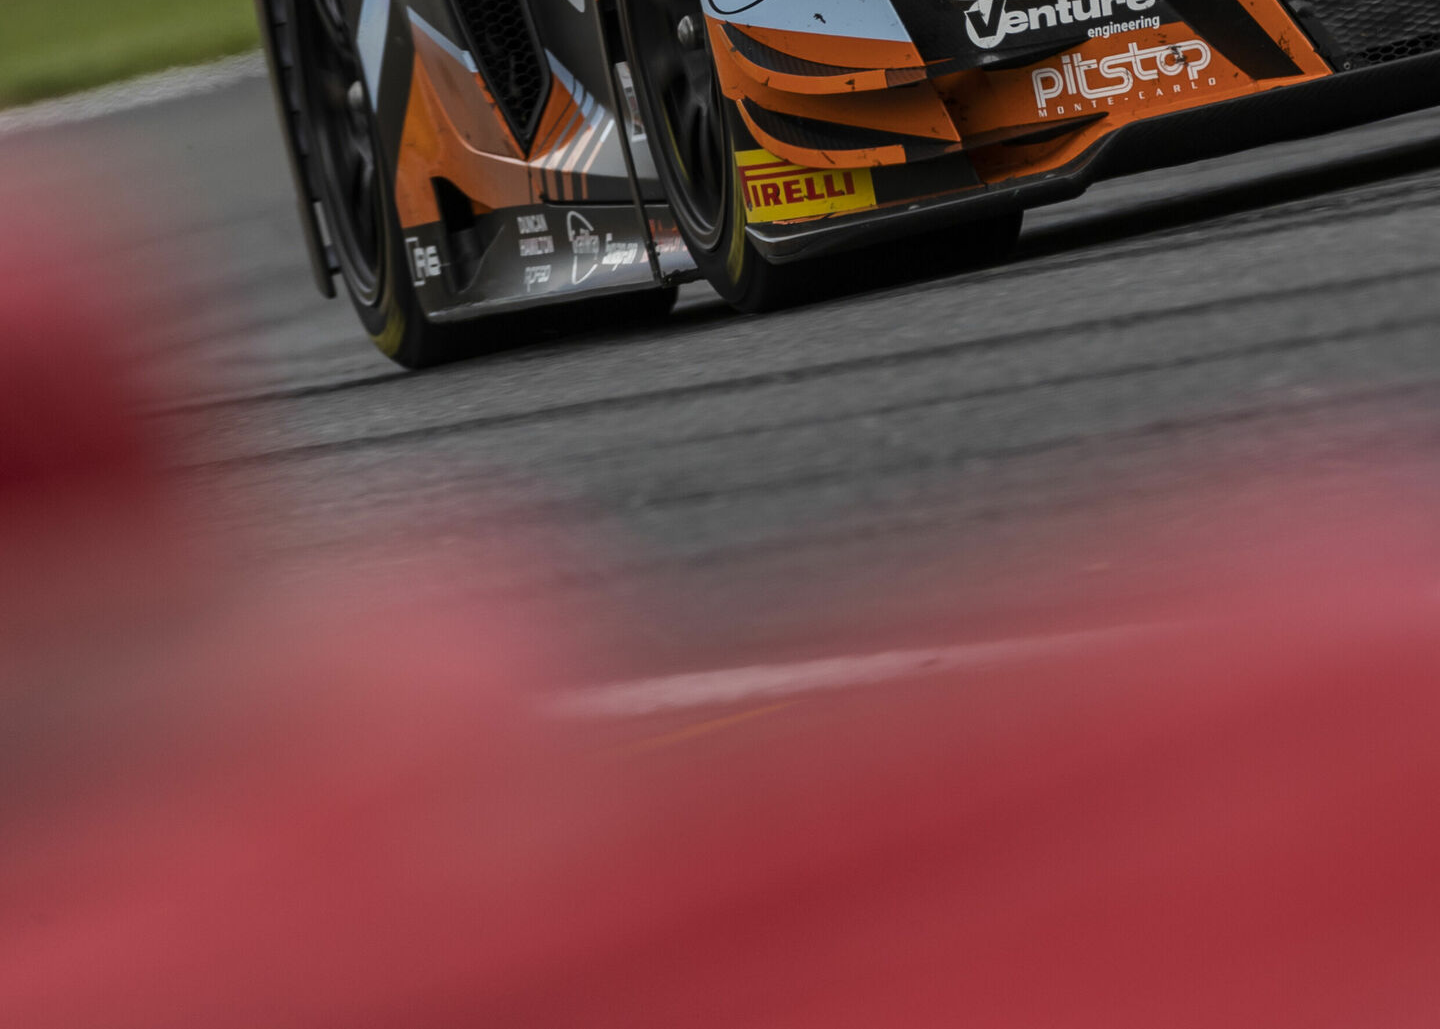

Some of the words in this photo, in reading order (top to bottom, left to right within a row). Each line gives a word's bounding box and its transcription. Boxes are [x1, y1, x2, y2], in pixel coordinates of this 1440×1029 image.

[1087, 15, 1160, 39] engineering
[1032, 39, 1212, 109] pitstop
[1038, 77, 1217, 118] MONTE-CARLO
